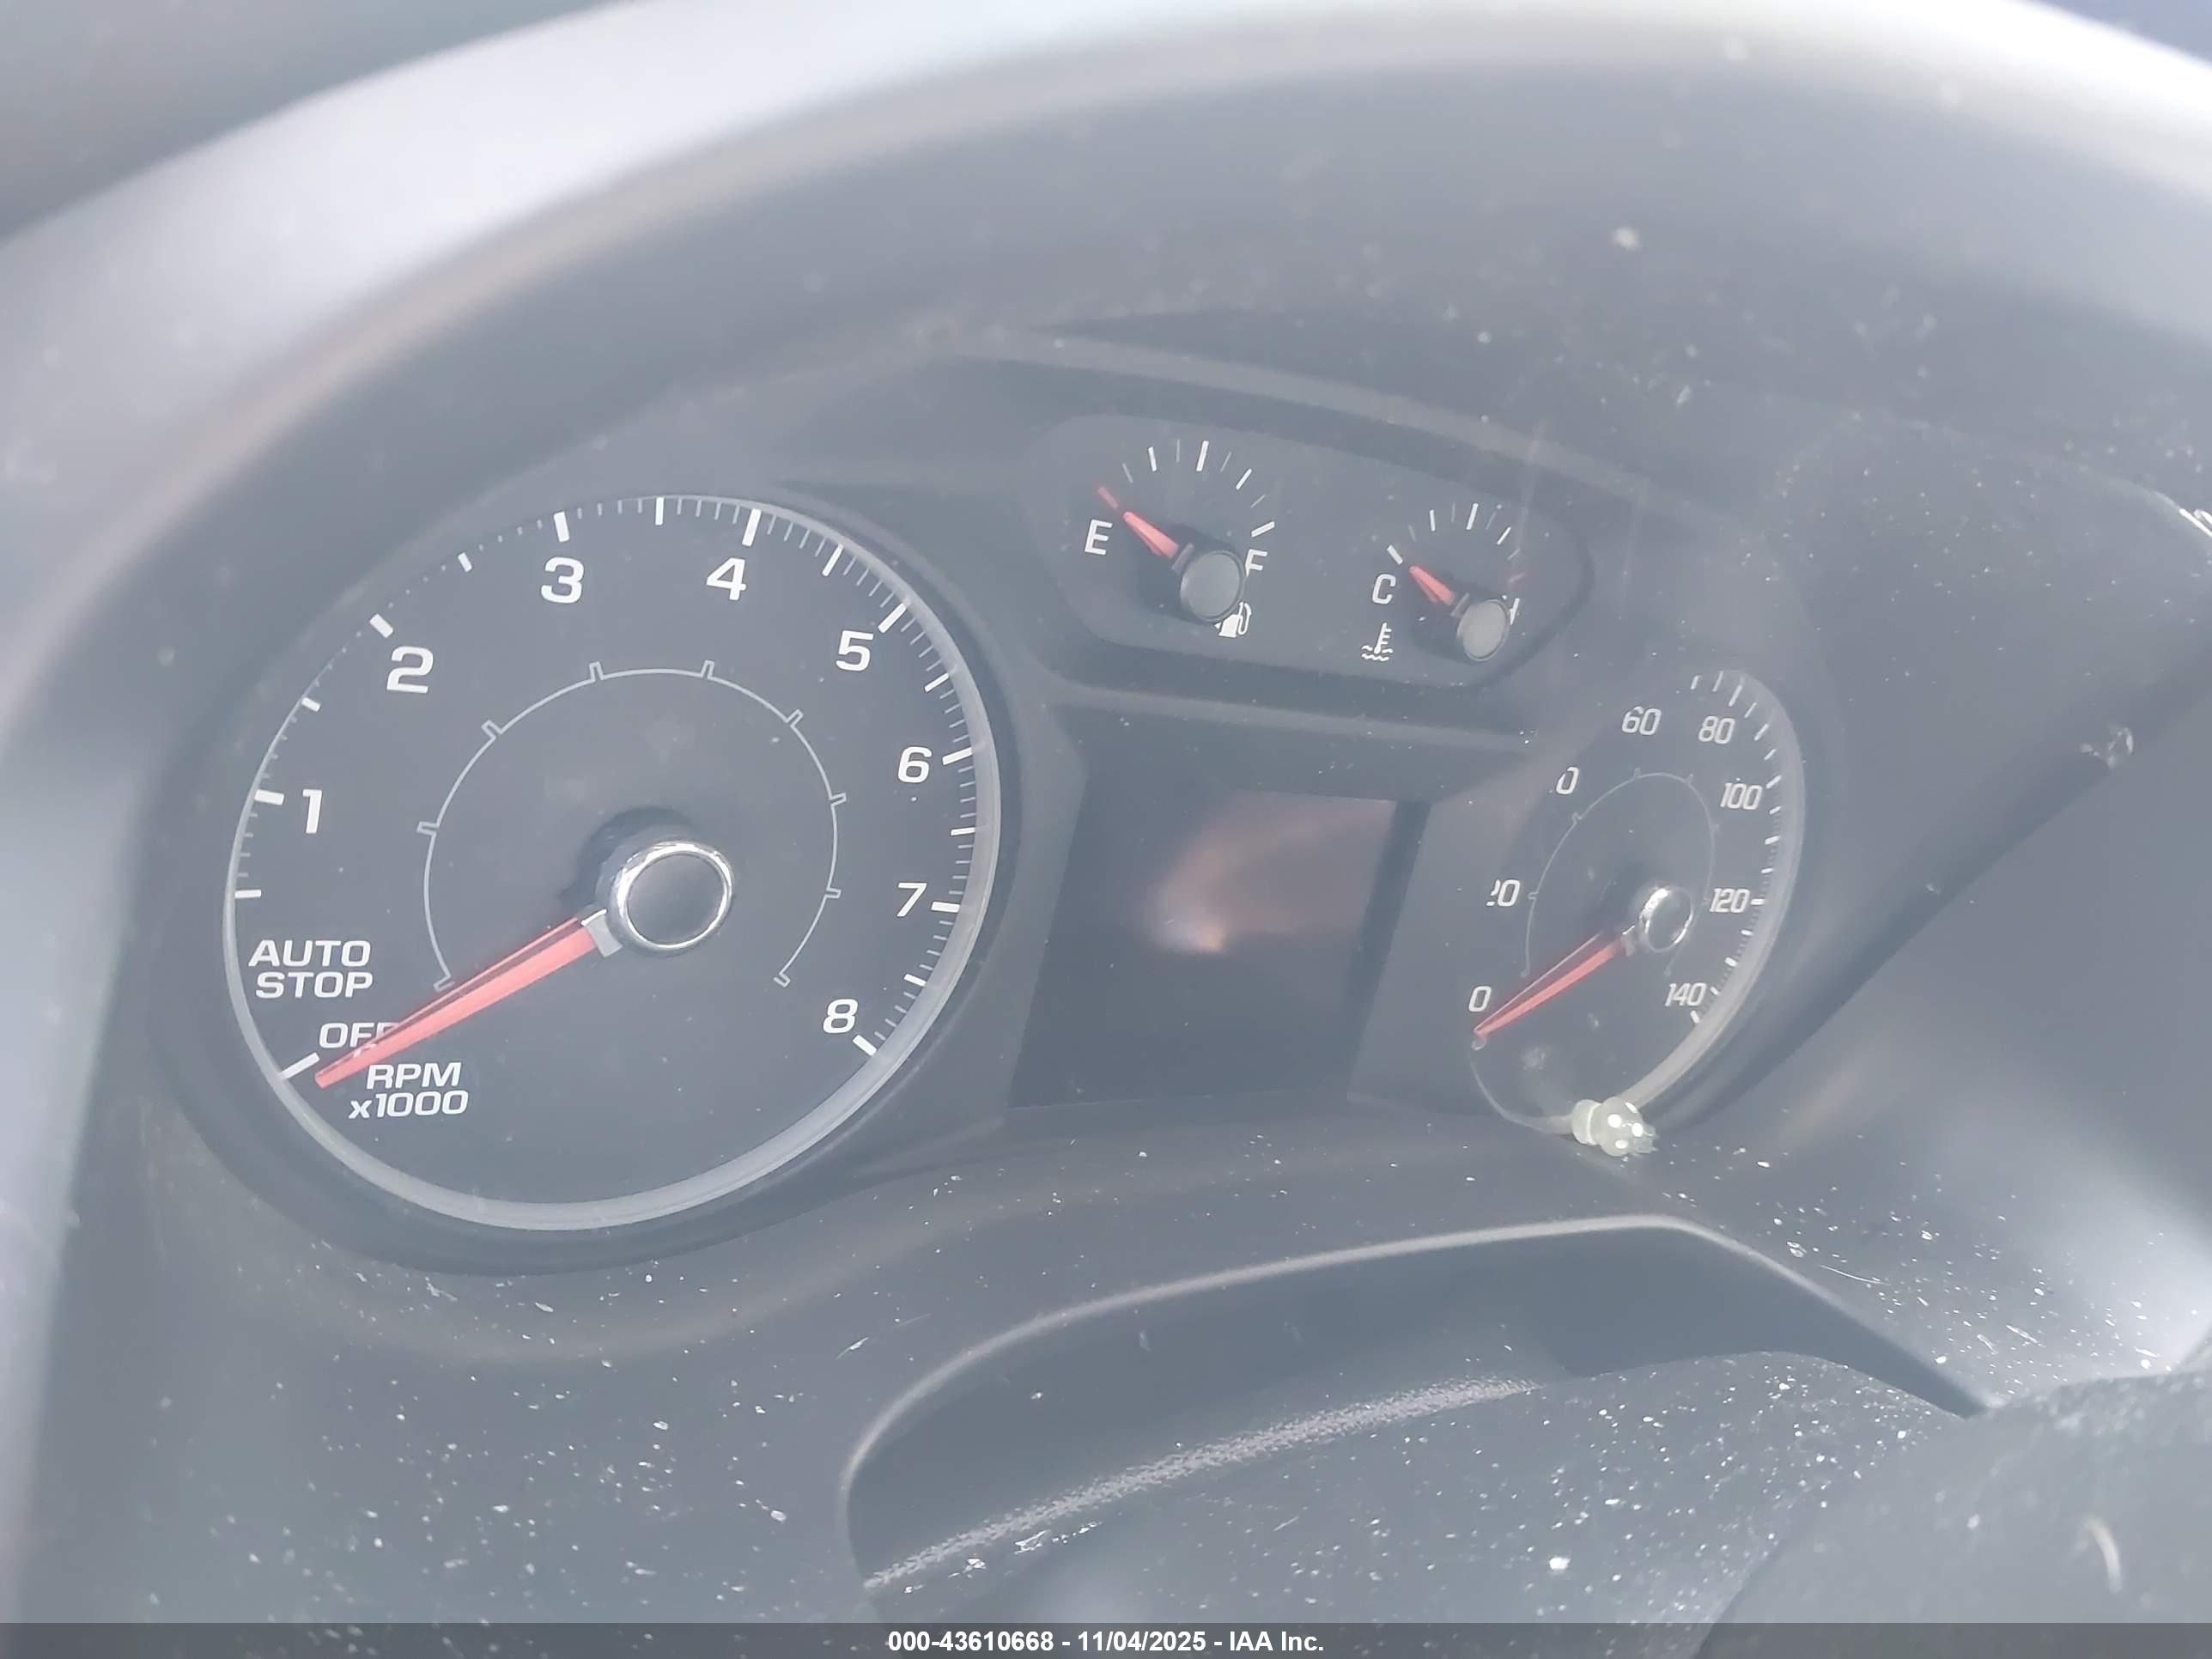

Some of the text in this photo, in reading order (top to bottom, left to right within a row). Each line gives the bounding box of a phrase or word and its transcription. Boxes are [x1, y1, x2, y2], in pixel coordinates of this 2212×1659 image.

[1085, 519, 1113, 556] E
[1244, 549, 1268, 577] F
[541, 556, 585, 604] 3
[706, 557, 747, 601] 4
[1372, 574, 1396, 605] C
[836, 629, 874, 672] 5
[386, 646, 434, 694] 2
[1621, 706, 1662, 736] 60
[1698, 715, 1735, 744] 80
[897, 746, 933, 783] 6
[302, 788, 323, 834] 1
[1720, 782, 1763, 811] 100
[896, 882, 927, 917] 7
[1710, 888, 1750, 913] 120
[248, 939, 371, 967] AUTO
[255, 971, 374, 999] STOP
[1468, 986, 1492, 1012] 0
[1665, 982, 1707, 1006] 140
[823, 999, 859, 1034] 8
[366, 1062, 462, 1089] RPM
[348, 1090, 469, 1119] x1000
